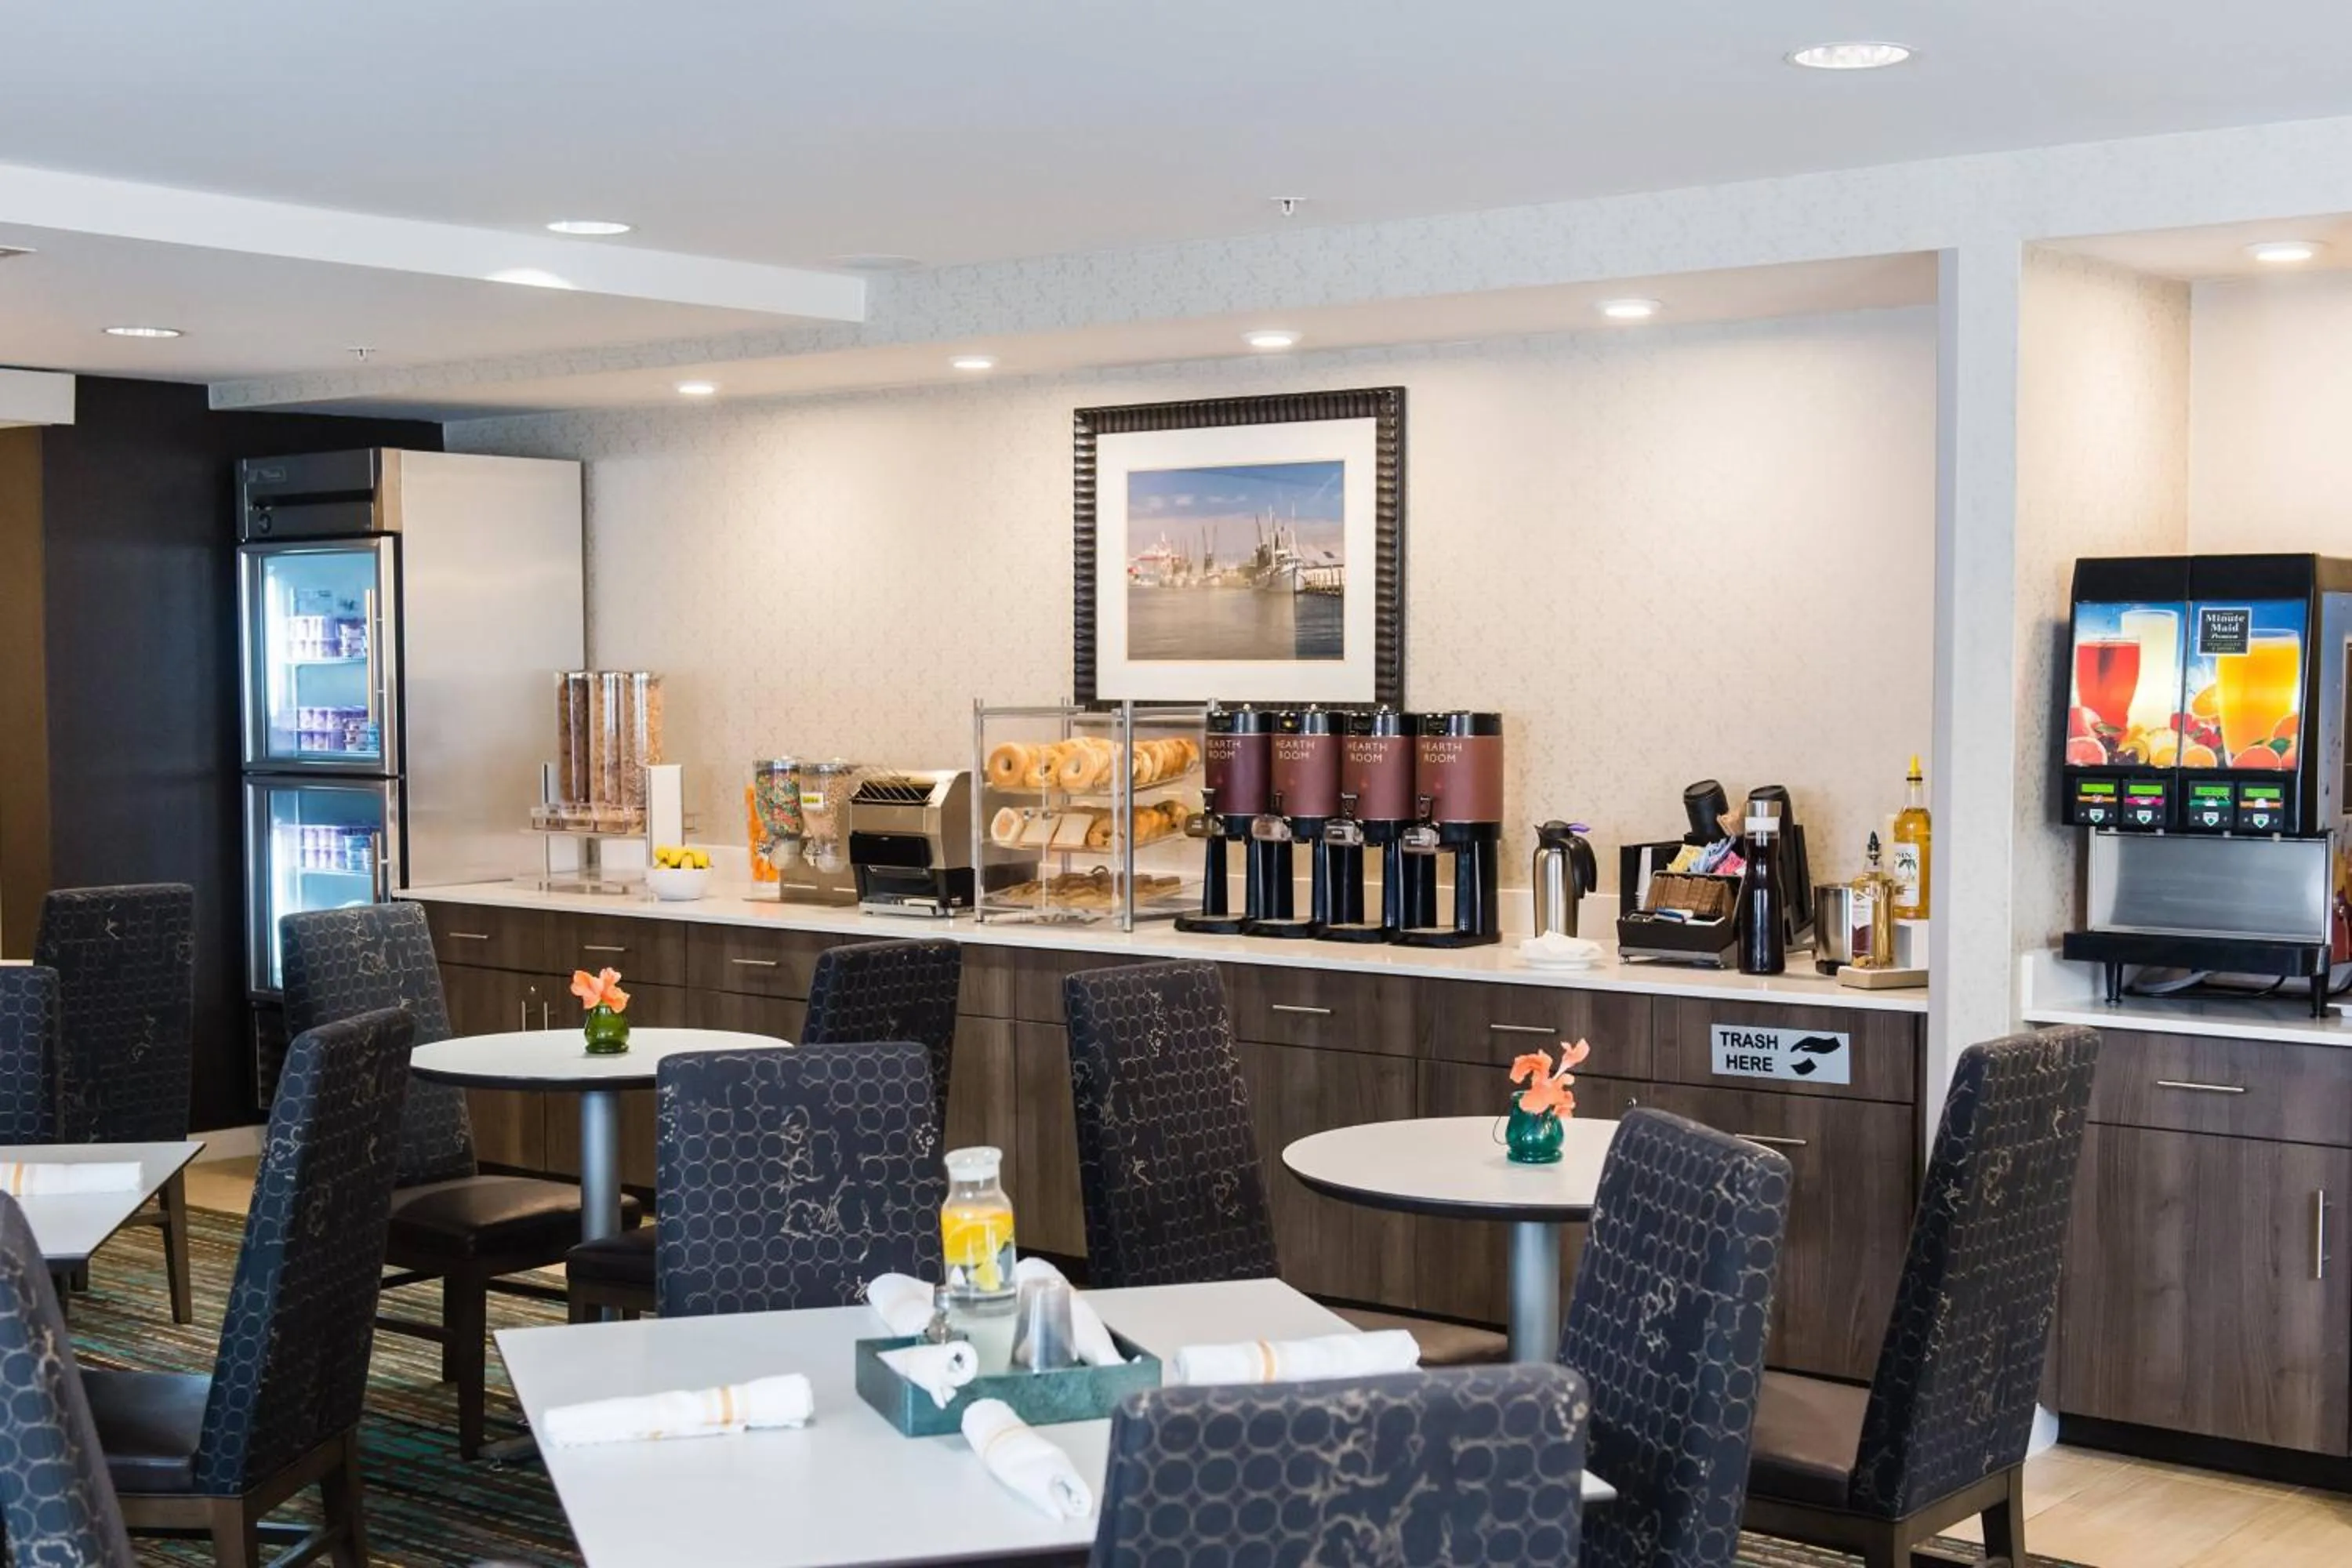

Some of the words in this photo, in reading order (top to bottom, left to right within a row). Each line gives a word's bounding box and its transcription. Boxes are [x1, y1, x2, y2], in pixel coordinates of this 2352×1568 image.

[2205, 614, 2246, 622] Minute
[2211, 622, 2239, 633] Maid
[1279, 750, 1310, 760] ROOM
[1350, 752, 1383, 763] ROOM
[1424, 753, 1457, 764] ROOM
[1719, 1031, 1779, 1051] TRASH
[1726, 1054, 1774, 1073] HERE
